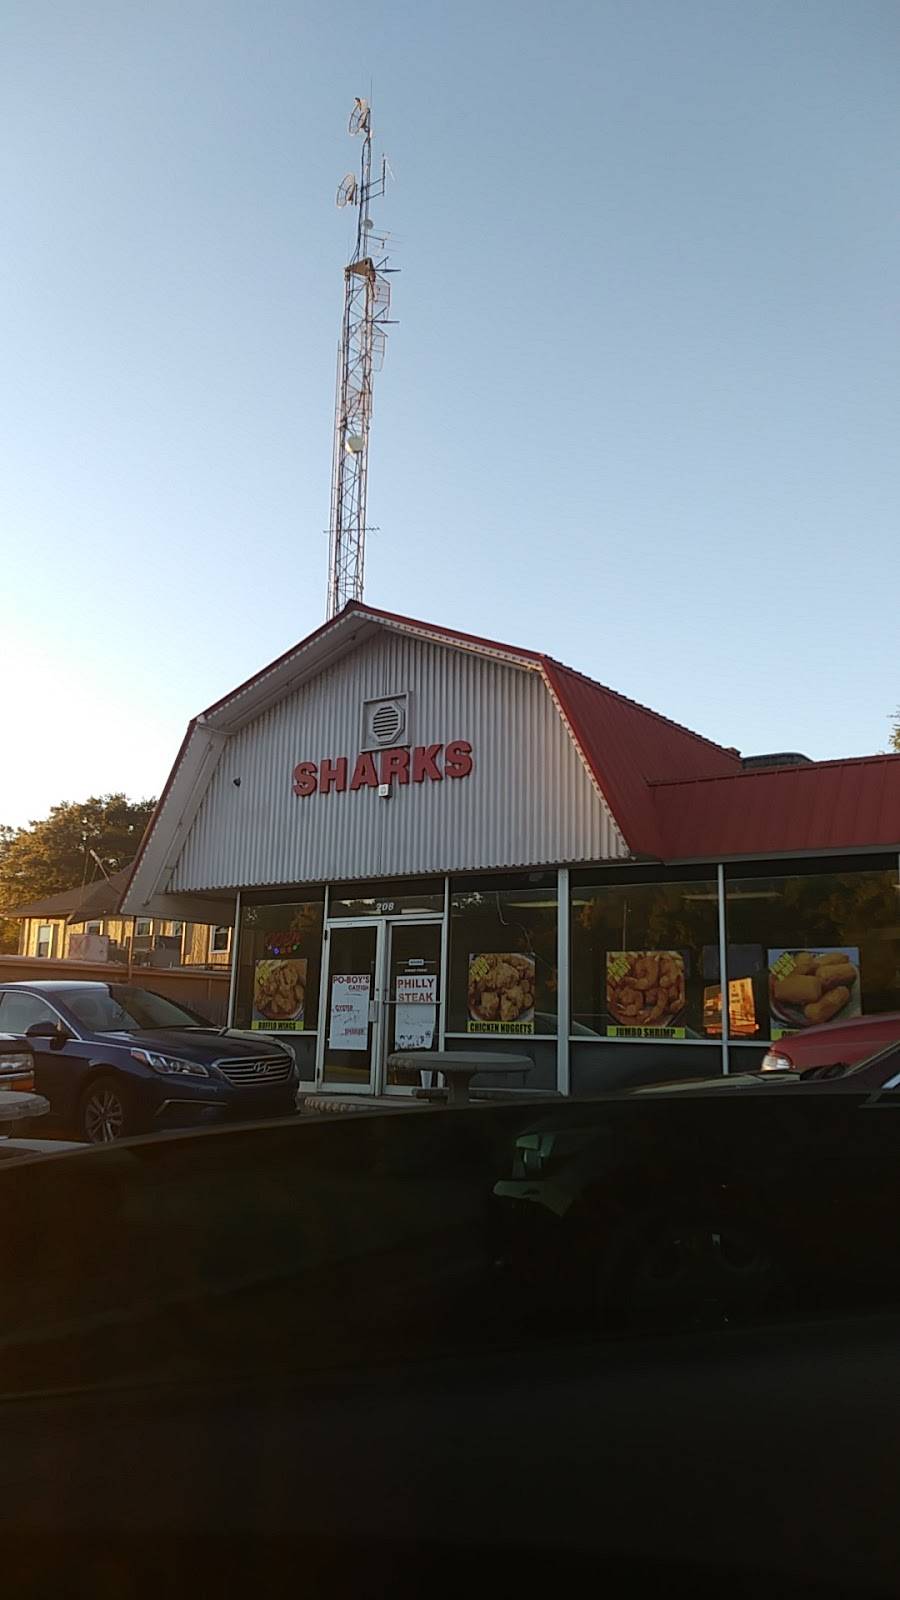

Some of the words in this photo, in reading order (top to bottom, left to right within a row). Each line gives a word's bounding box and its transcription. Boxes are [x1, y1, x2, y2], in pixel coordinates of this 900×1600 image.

[292, 740, 473, 797] SHARKS
[375, 901, 396, 912] 208
[397, 978, 434, 989] PHILLY
[398, 993, 433, 1002] STEAK
[469, 1022, 500, 1034] CHICKEN
[500, 1023, 533, 1035] NUGGETS
[615, 1026, 642, 1037] JUMBO
[643, 1027, 676, 1038] SHRIMP
